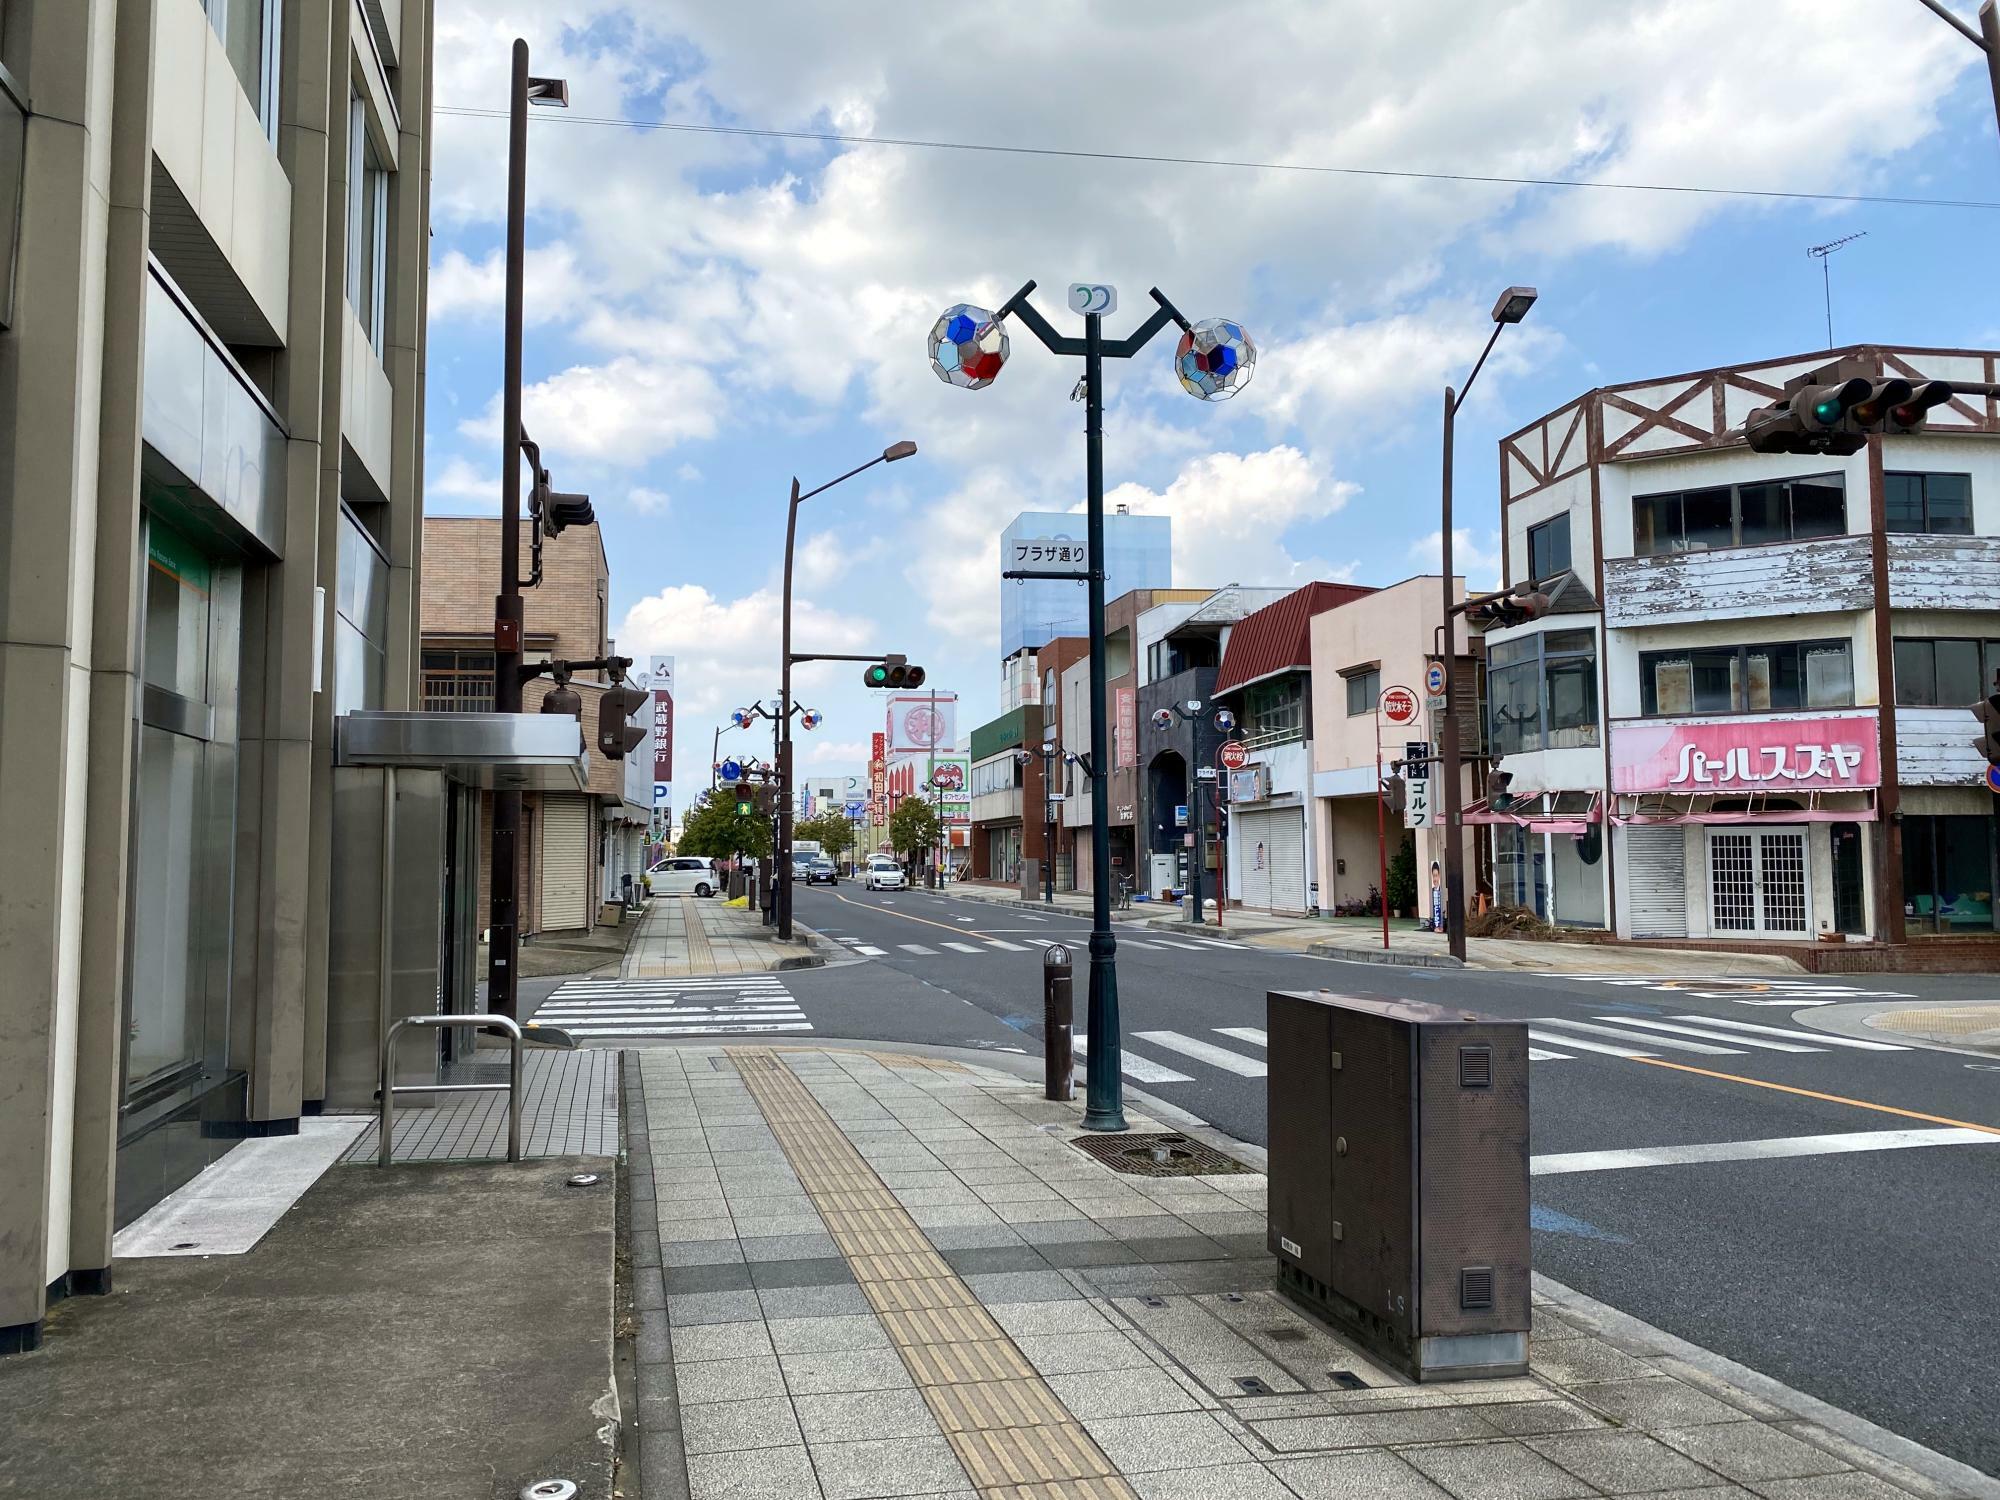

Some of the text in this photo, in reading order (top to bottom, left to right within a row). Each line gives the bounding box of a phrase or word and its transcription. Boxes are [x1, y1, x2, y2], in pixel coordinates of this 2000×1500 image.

[1016, 546, 1084, 562] プラザ通り
[1385, 700, 1413, 714] 防火水そう
[654, 701, 668, 763] 武蔵野銀行
[1223, 751, 1244, 761] 消火栓
[1669, 743, 1861, 783] パールスズヤ
[654, 785, 668, 804] P
[1411, 781, 1427, 826] ゴルフ
